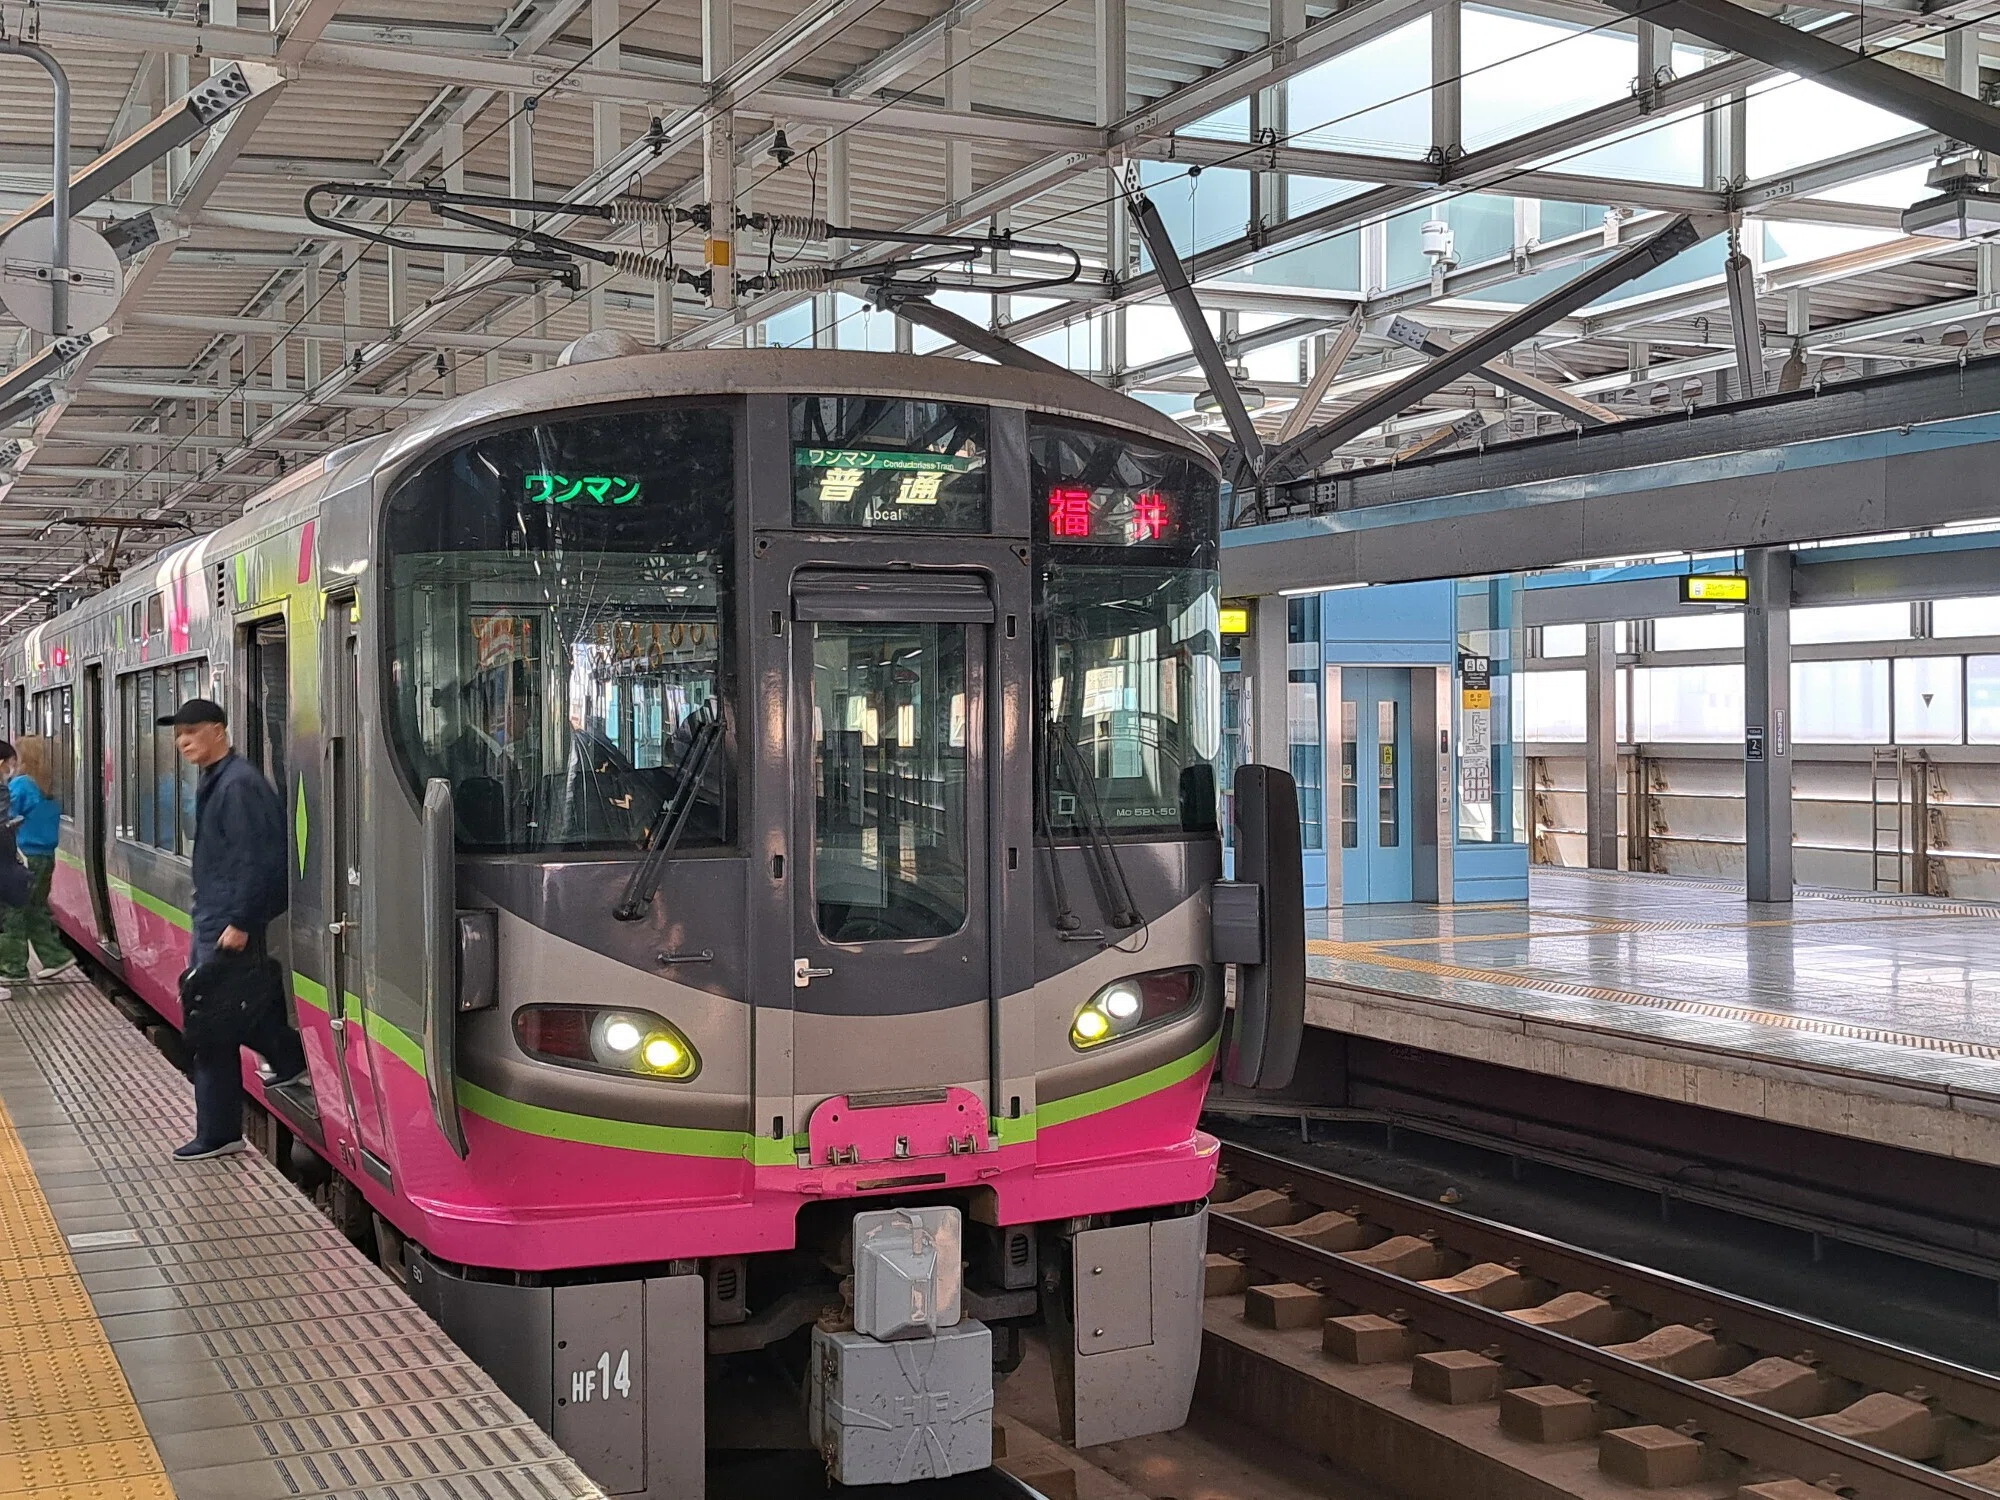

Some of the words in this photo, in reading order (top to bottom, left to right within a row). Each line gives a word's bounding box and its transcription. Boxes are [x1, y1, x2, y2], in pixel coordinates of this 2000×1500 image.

[808, 449, 876, 466] ワンマン
[525, 475, 640, 504] ワンマン
[818, 468, 946, 505] 普通
[865, 508, 903, 521] Local
[1049, 489, 1169, 539] 福井
